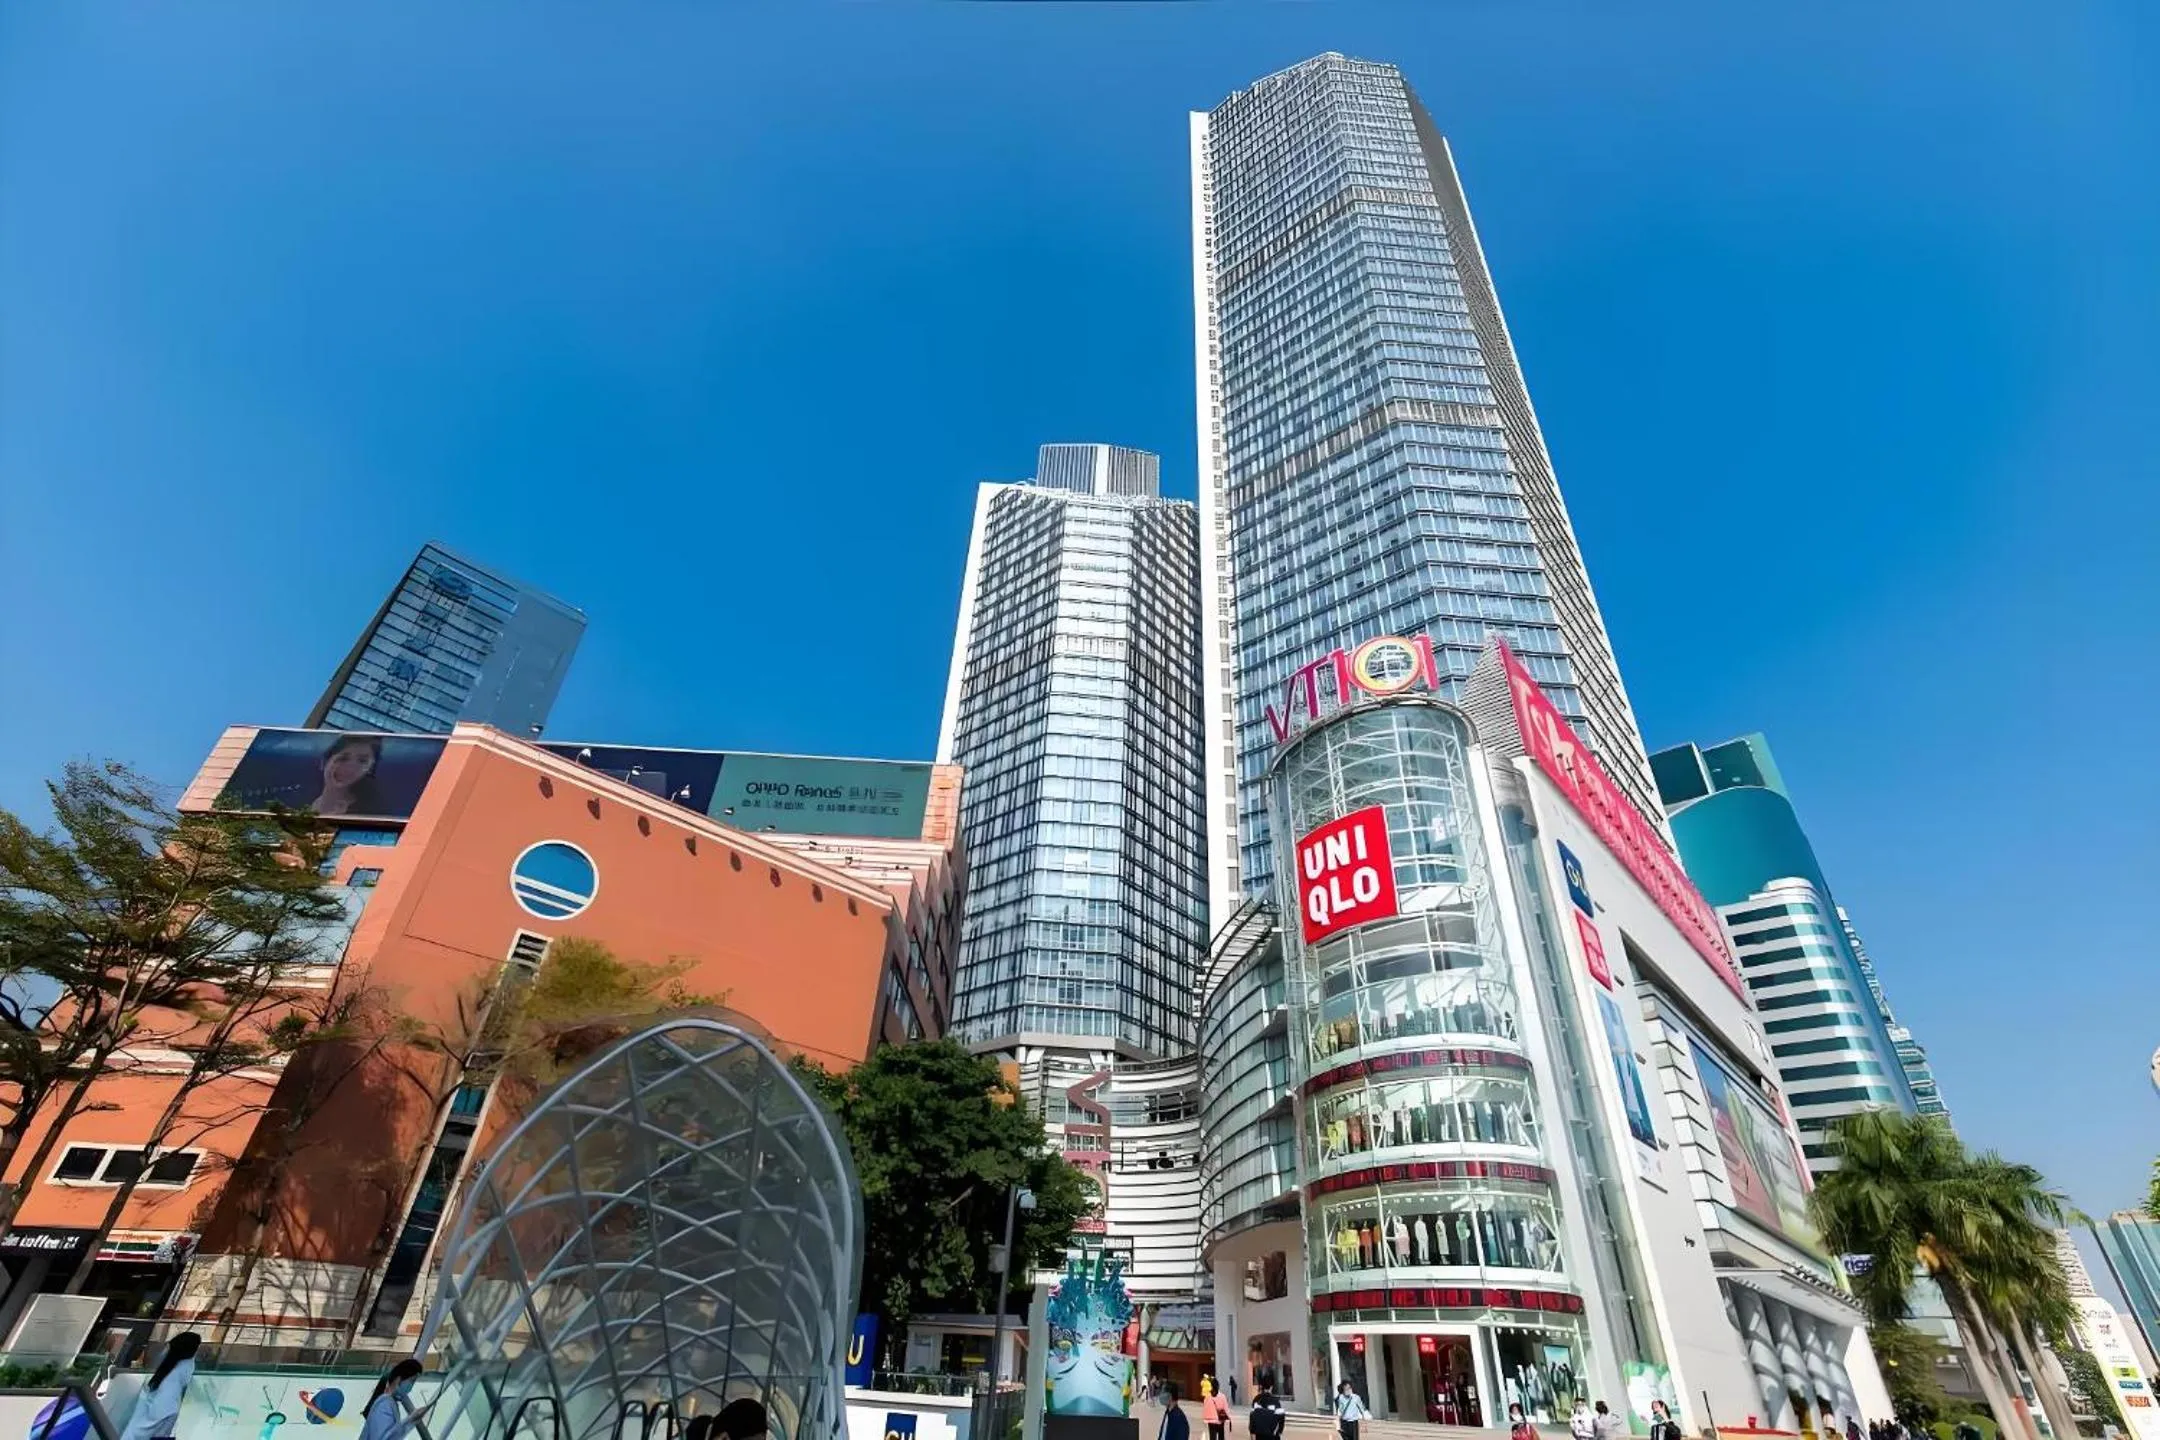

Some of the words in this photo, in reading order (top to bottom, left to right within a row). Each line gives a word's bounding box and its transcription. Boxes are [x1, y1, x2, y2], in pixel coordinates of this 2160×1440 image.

[1303, 824, 1368, 880] UNI
[1308, 866, 1380, 926] QLO
[847, 1333, 865, 1366] U
